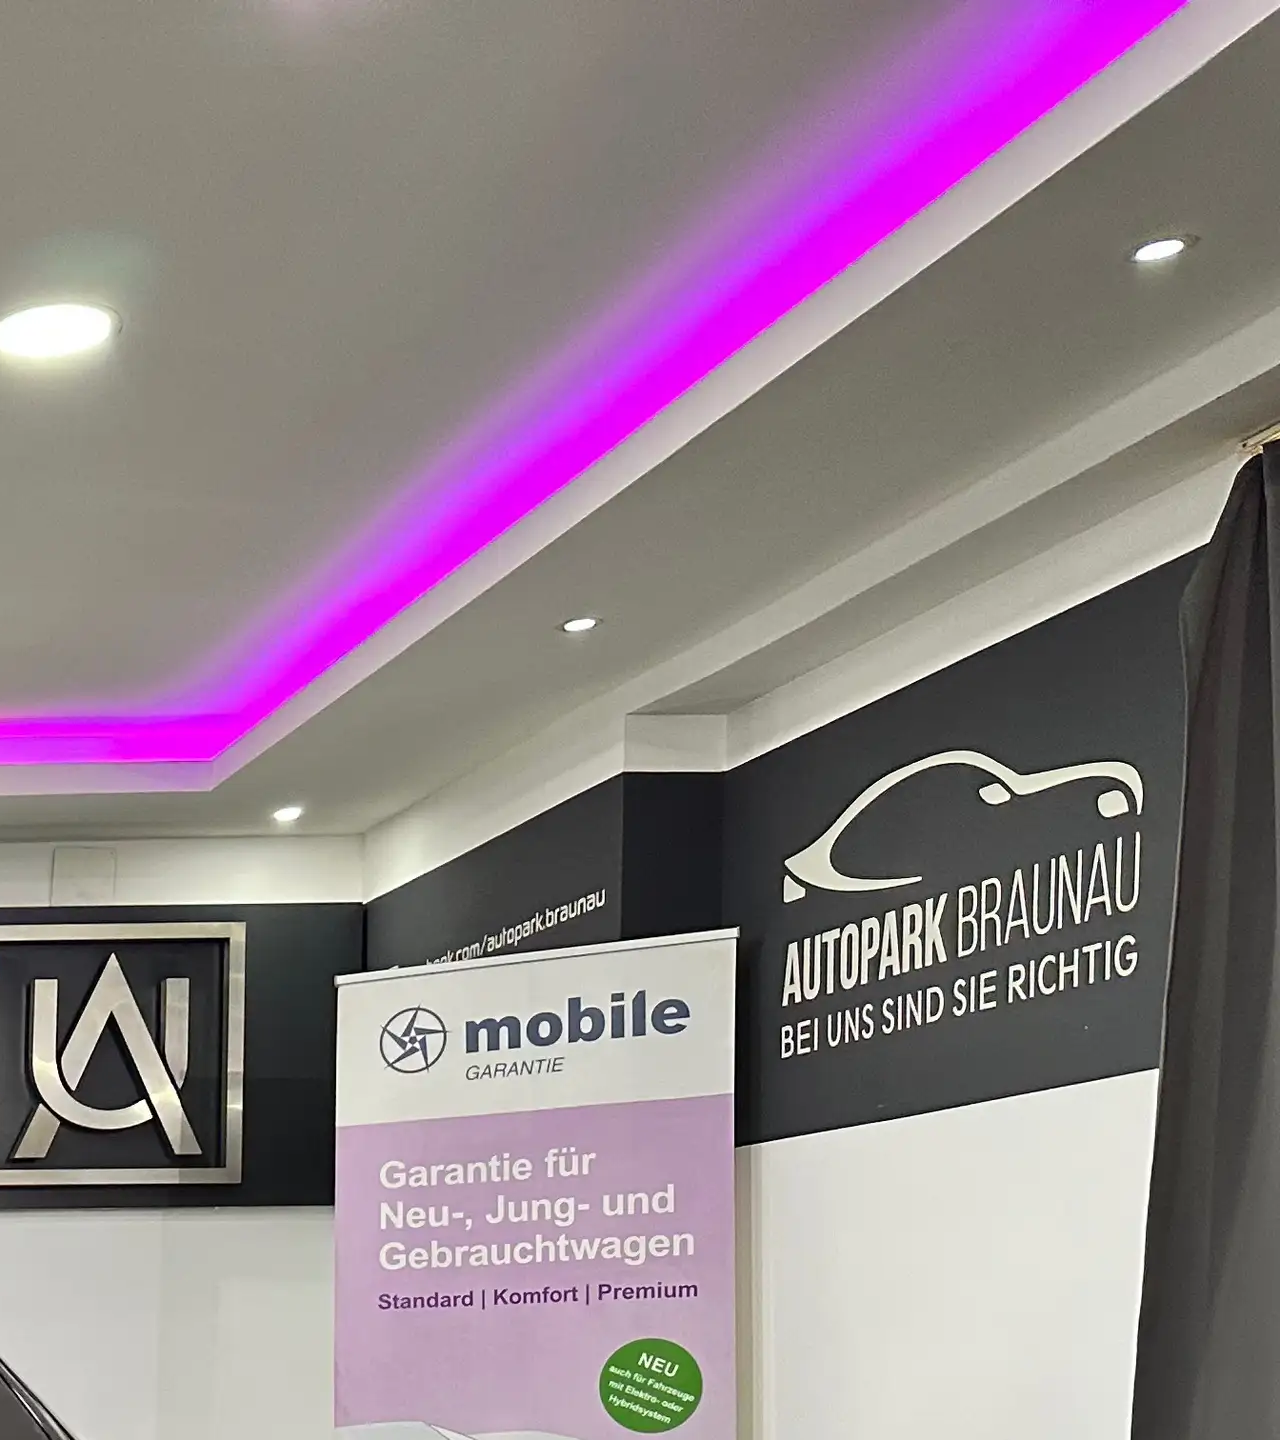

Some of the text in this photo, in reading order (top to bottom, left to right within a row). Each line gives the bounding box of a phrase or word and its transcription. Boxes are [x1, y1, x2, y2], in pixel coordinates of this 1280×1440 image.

[782, 831, 1141, 1008] AUTOPARK BRAUNAU
[780, 935, 1139, 1060] BEI UNS SIND SIE RICHTIG
[465, 989, 691, 1054] mobile
[465, 1056, 565, 1081] GARANTIE
[379, 1147, 596, 1189] Garantie für
[380, 1184, 675, 1231] Neu-, Jung- und
[379, 1232, 695, 1271] Gebrauchtwagen
[378, 1290, 474, 1311] Standard
[493, 1286, 579, 1306] Komfort
[597, 1282, 698, 1303] Premium
[638, 1352, 679, 1377] NEU
[608, 1366, 695, 1402] auch für Fahrzeuge
[608, 1381, 625, 1391] mit
[662, 1400, 684, 1412] oder
[608, 1394, 671, 1424] Hybridsystem
